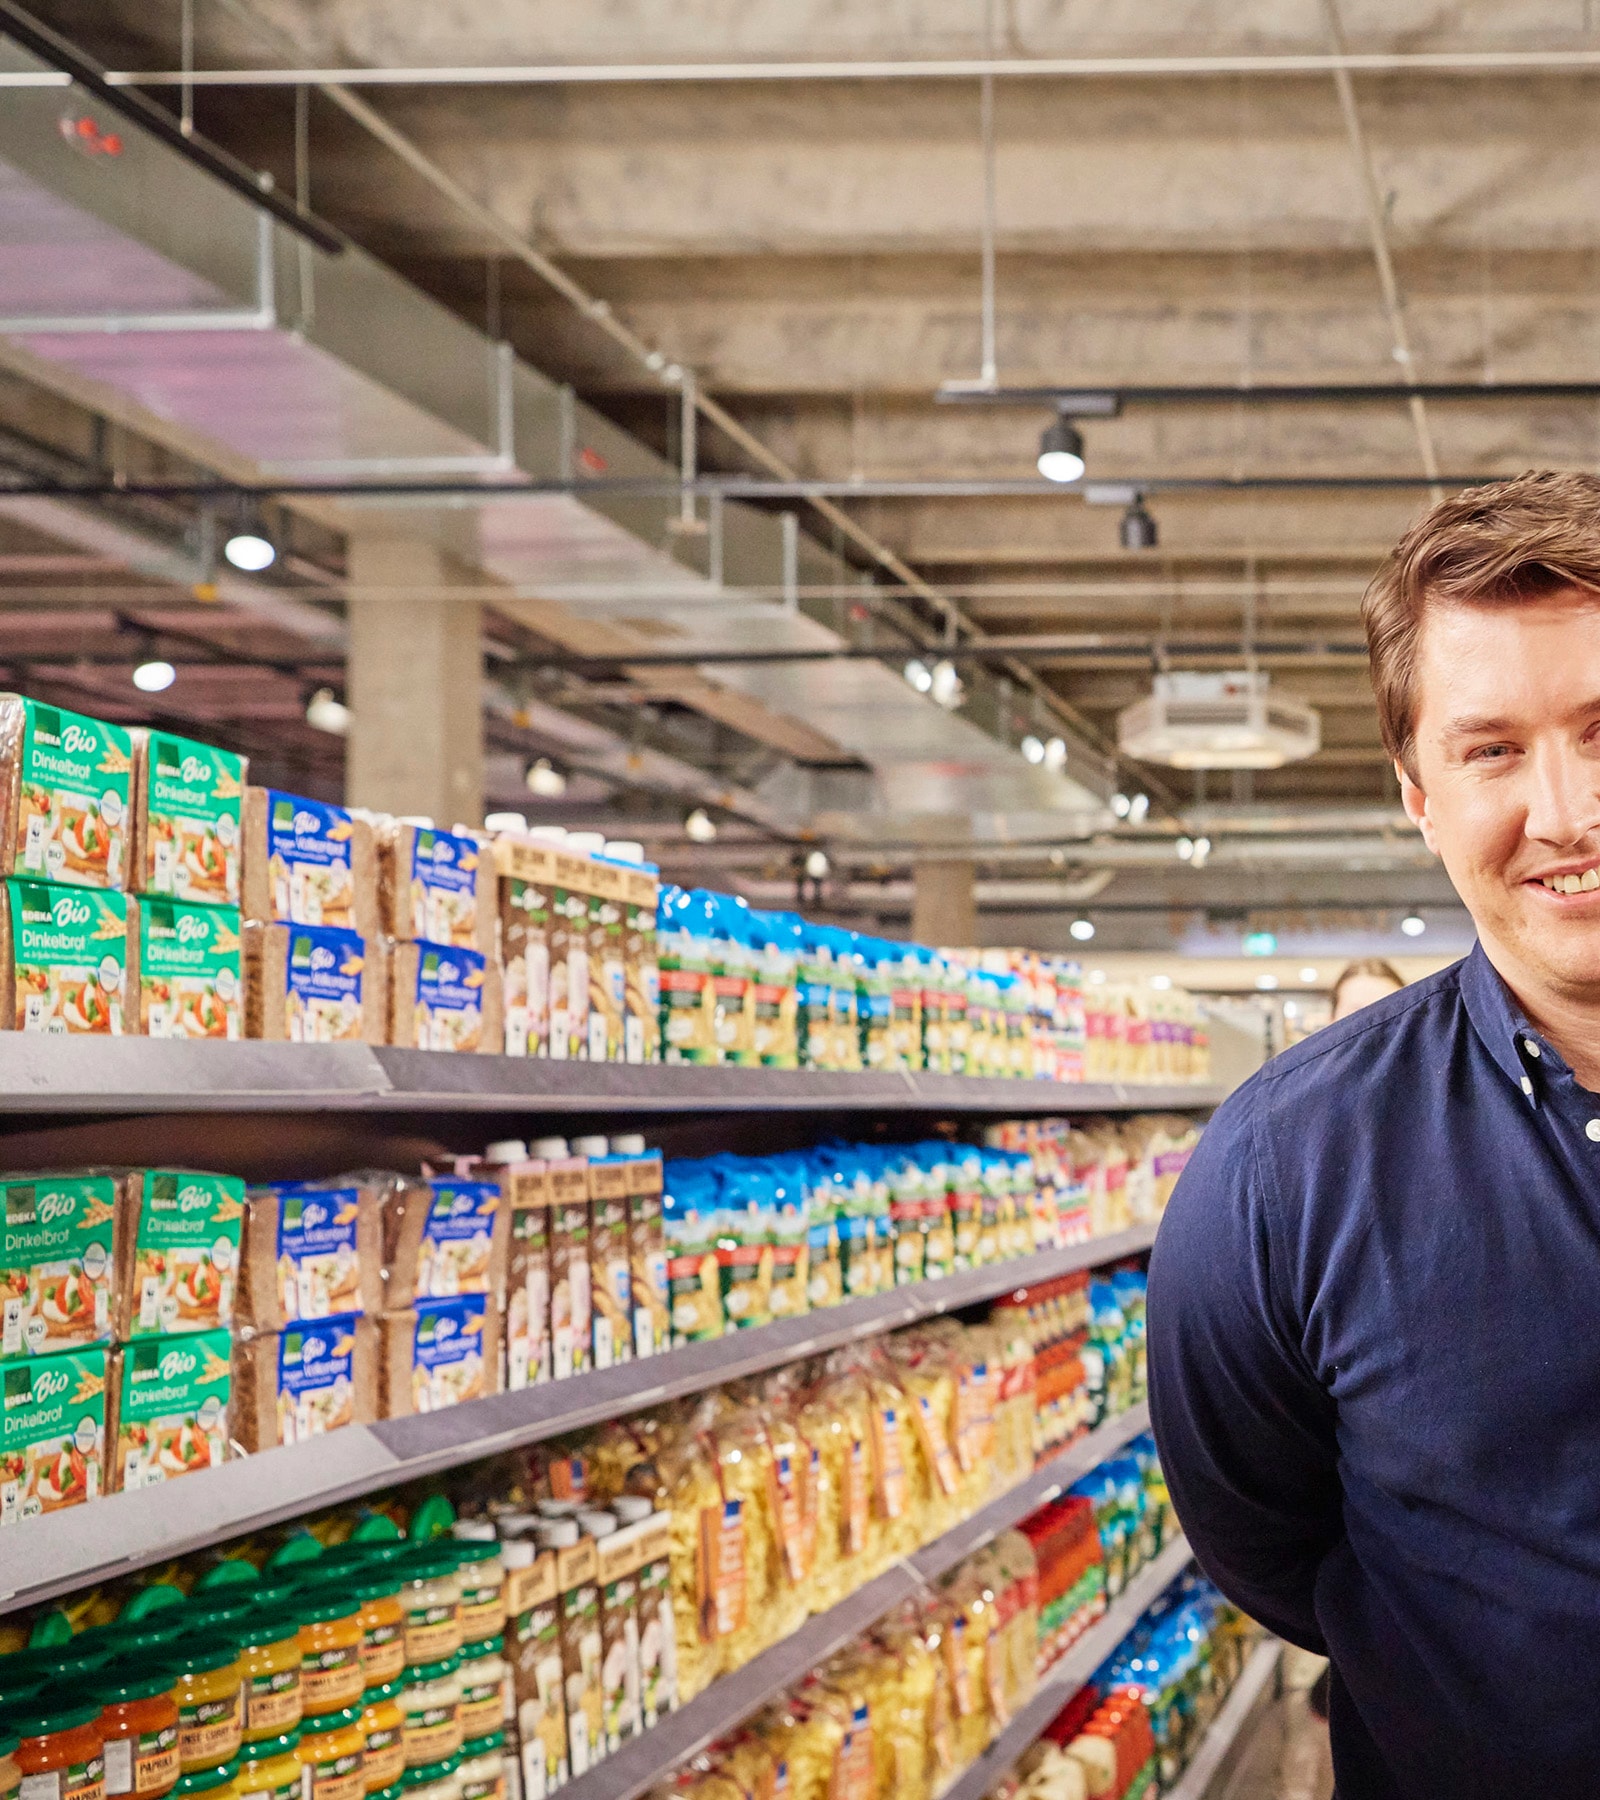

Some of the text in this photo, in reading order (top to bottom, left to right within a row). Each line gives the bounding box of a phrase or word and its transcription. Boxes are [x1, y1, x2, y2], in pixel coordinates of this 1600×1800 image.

[62, 725, 97, 754] Bio
[32, 749, 91, 780] Dinkelbrot
[181, 755, 212, 783] Bio
[53, 898, 91, 928] Bio
[22, 929, 86, 950] Dinkelbrot
[176, 915, 210, 943] Bio
[147, 944, 205, 964] Dinkelbrot
[37, 1192, 76, 1225] Bio
[178, 1185, 212, 1213] Bio
[5, 1212, 37, 1225] EDEKA
[147, 1217, 205, 1234] Dinkelbrot
[5, 1228, 70, 1252] Dinkelbrot
[159, 1351, 196, 1382] Bio
[33, 1370, 68, 1404] Bio
[129, 1384, 189, 1407] Dinkelbrot
[4, 1405, 63, 1434] Dinkelbrot
